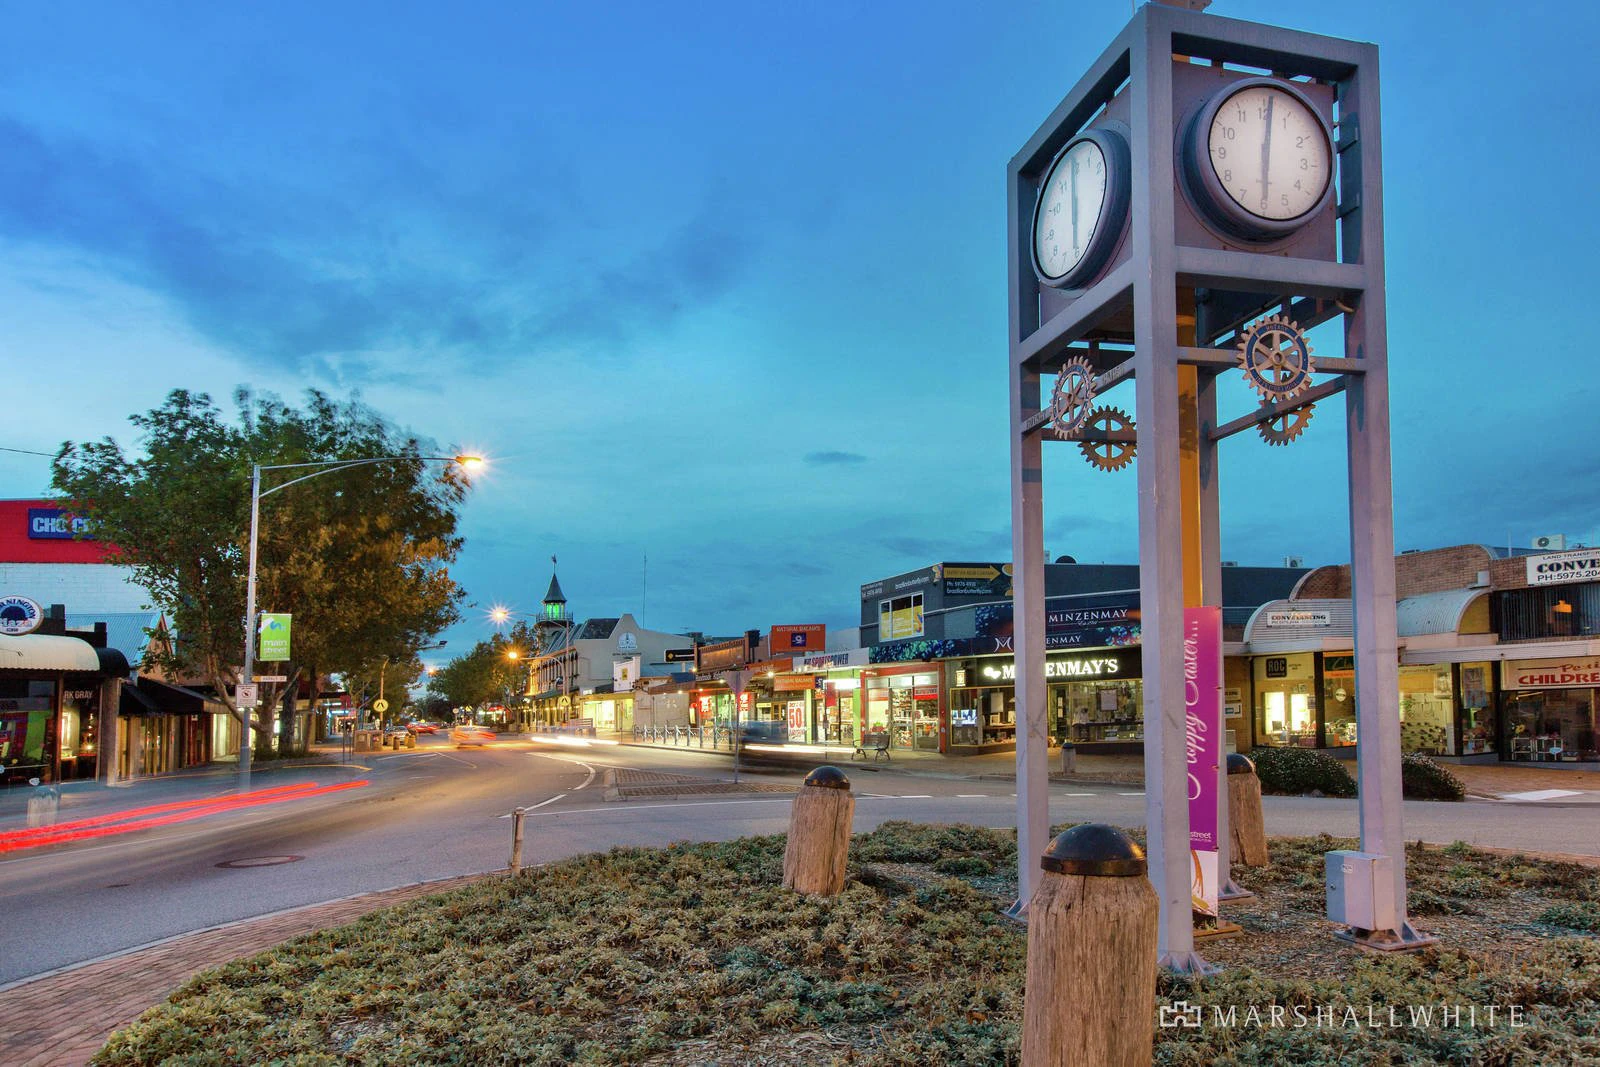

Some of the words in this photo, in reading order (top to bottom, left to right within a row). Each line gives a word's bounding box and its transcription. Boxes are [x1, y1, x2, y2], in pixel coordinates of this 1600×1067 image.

[1237, 110, 1246, 122] 11
[1282, 117, 1287, 129] 1
[1222, 127, 1235, 140] 10
[1296, 136, 1304, 148] 2
[1218, 147, 1226, 159] 9
[1300, 158, 1308, 170] 3
[1224, 169, 1232, 181] 8
[1293, 179, 1302, 191] 4
[1240, 188, 1248, 201] 7
[1281, 193, 1289, 206] 5
[1260, 198, 1267, 210] 6
[1048, 609, 1128, 623] MINZENMAY
[1518, 672, 1600, 685] CHILDRE
[789, 708, 802, 728] 50
